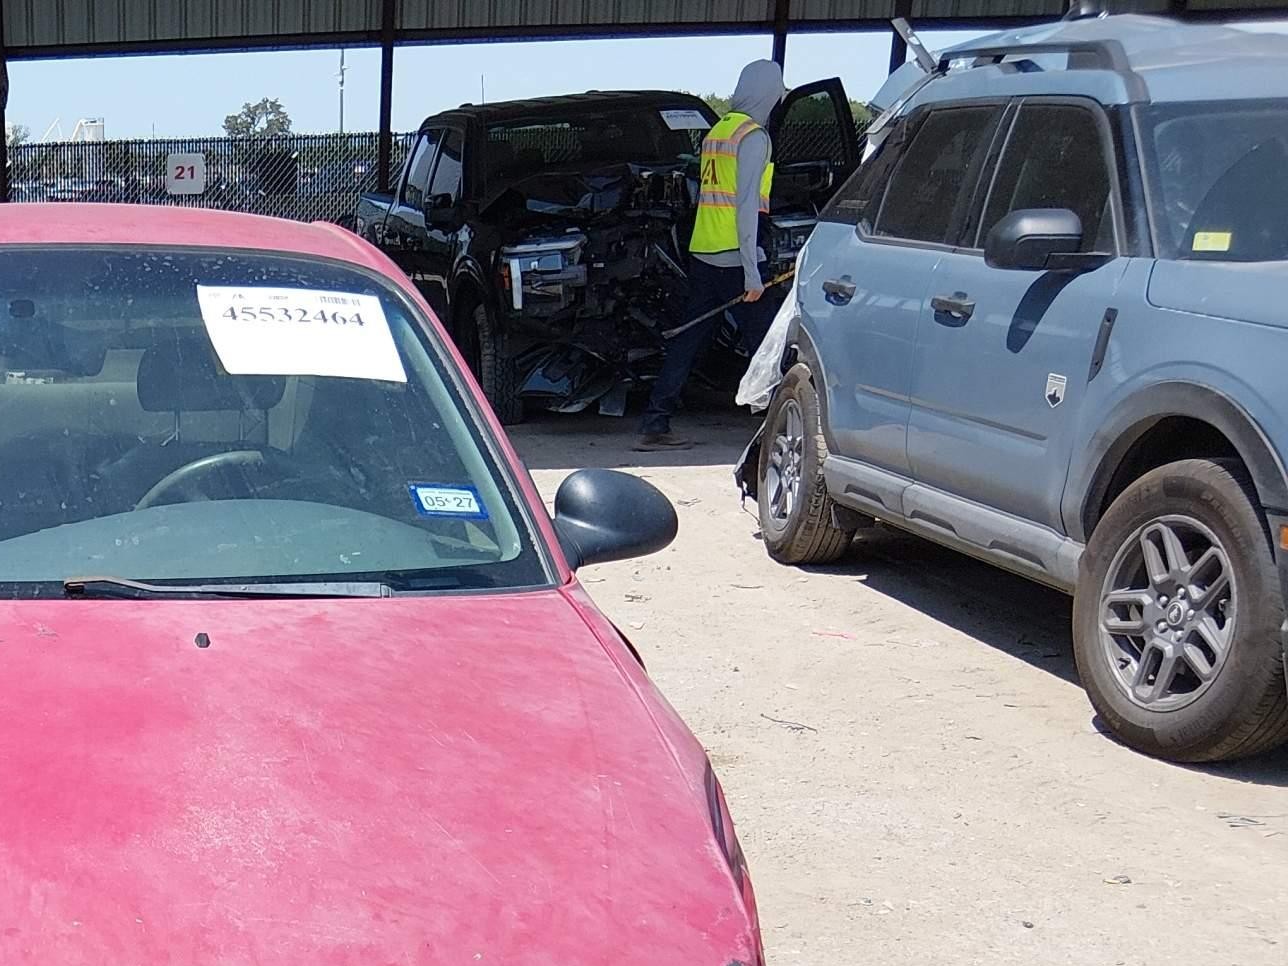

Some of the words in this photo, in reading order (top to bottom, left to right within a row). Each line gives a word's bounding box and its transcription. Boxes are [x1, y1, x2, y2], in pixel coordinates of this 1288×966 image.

[174, 165, 195, 180] 21
[222, 306, 365, 327] 45532464
[453, 496, 472, 508] 27
